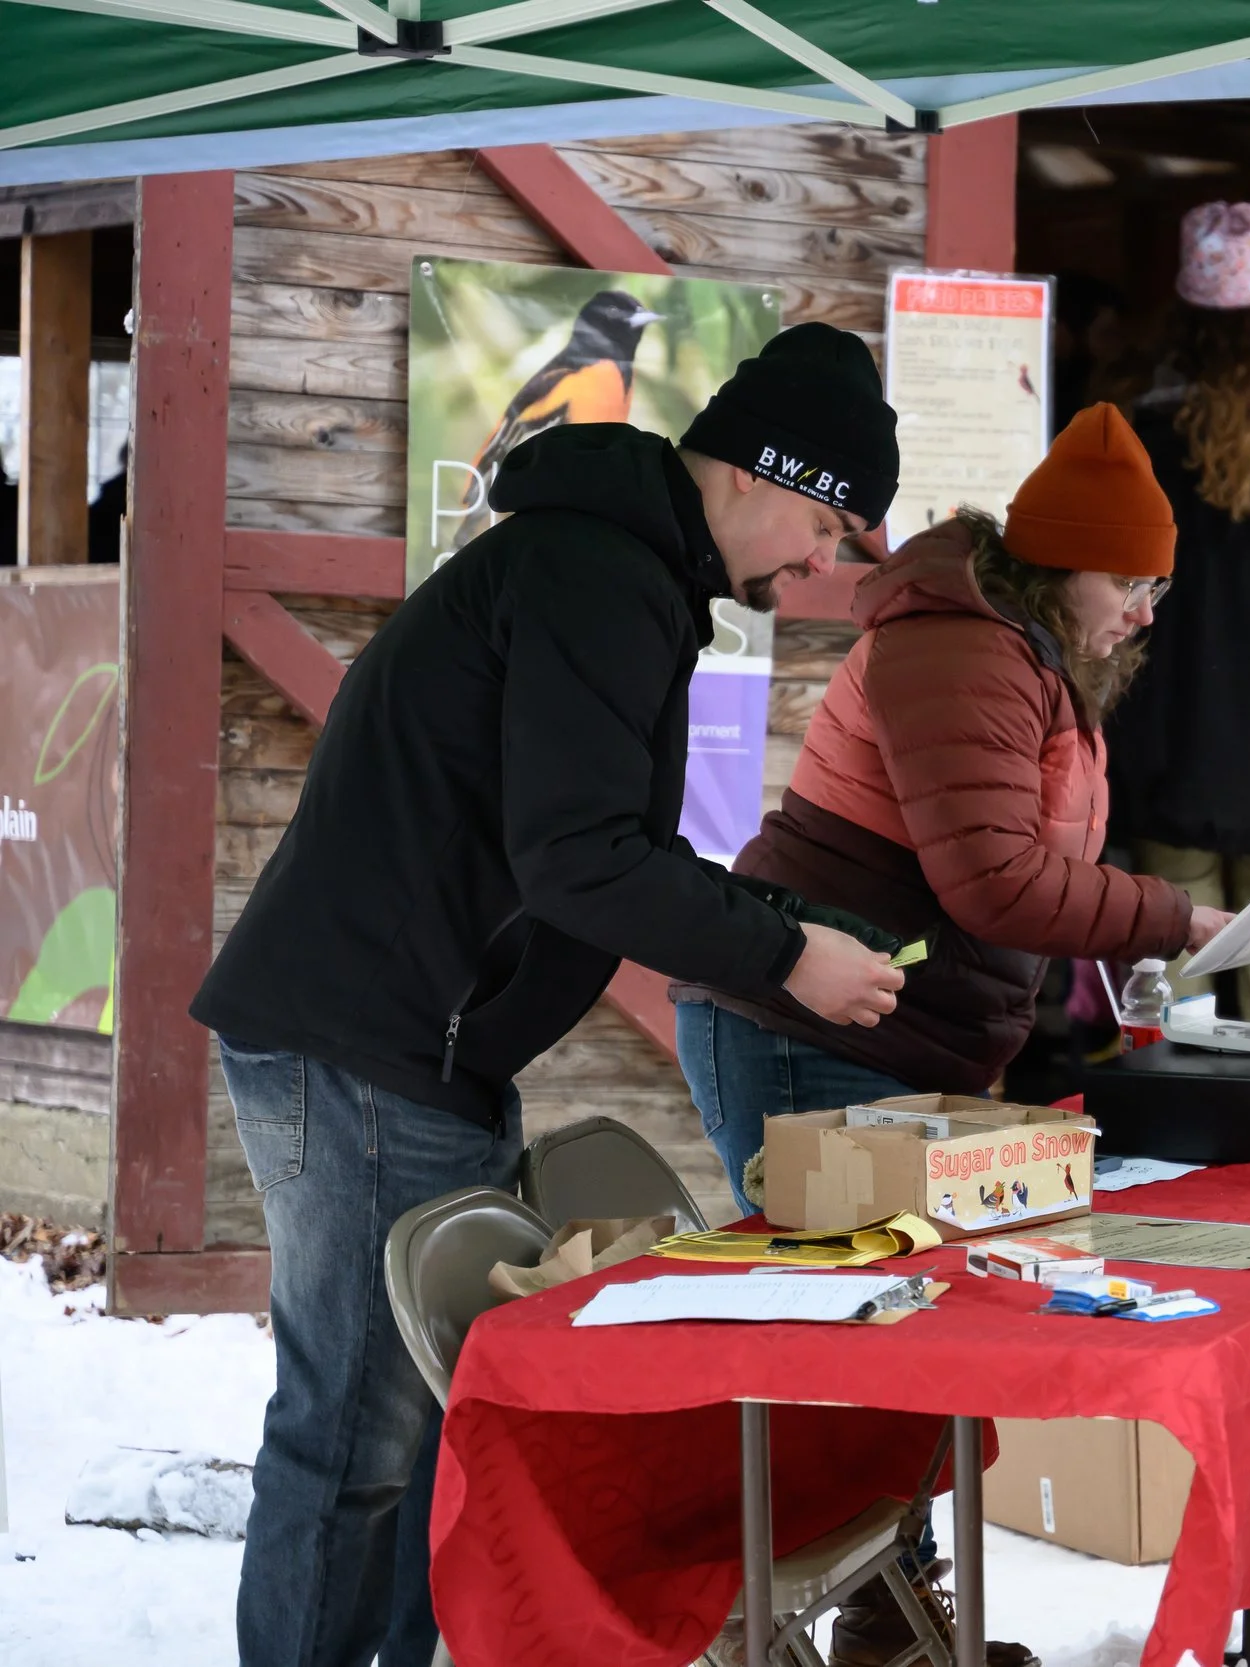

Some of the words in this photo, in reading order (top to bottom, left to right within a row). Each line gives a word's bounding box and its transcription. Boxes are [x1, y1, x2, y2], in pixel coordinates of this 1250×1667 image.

[773, 474, 796, 487] WATER
[799, 484, 830, 502] BREWING
[928, 1146, 995, 1181] Sugar
[999, 1140, 1027, 1168] on
[1031, 1131, 1093, 1162] Snow
